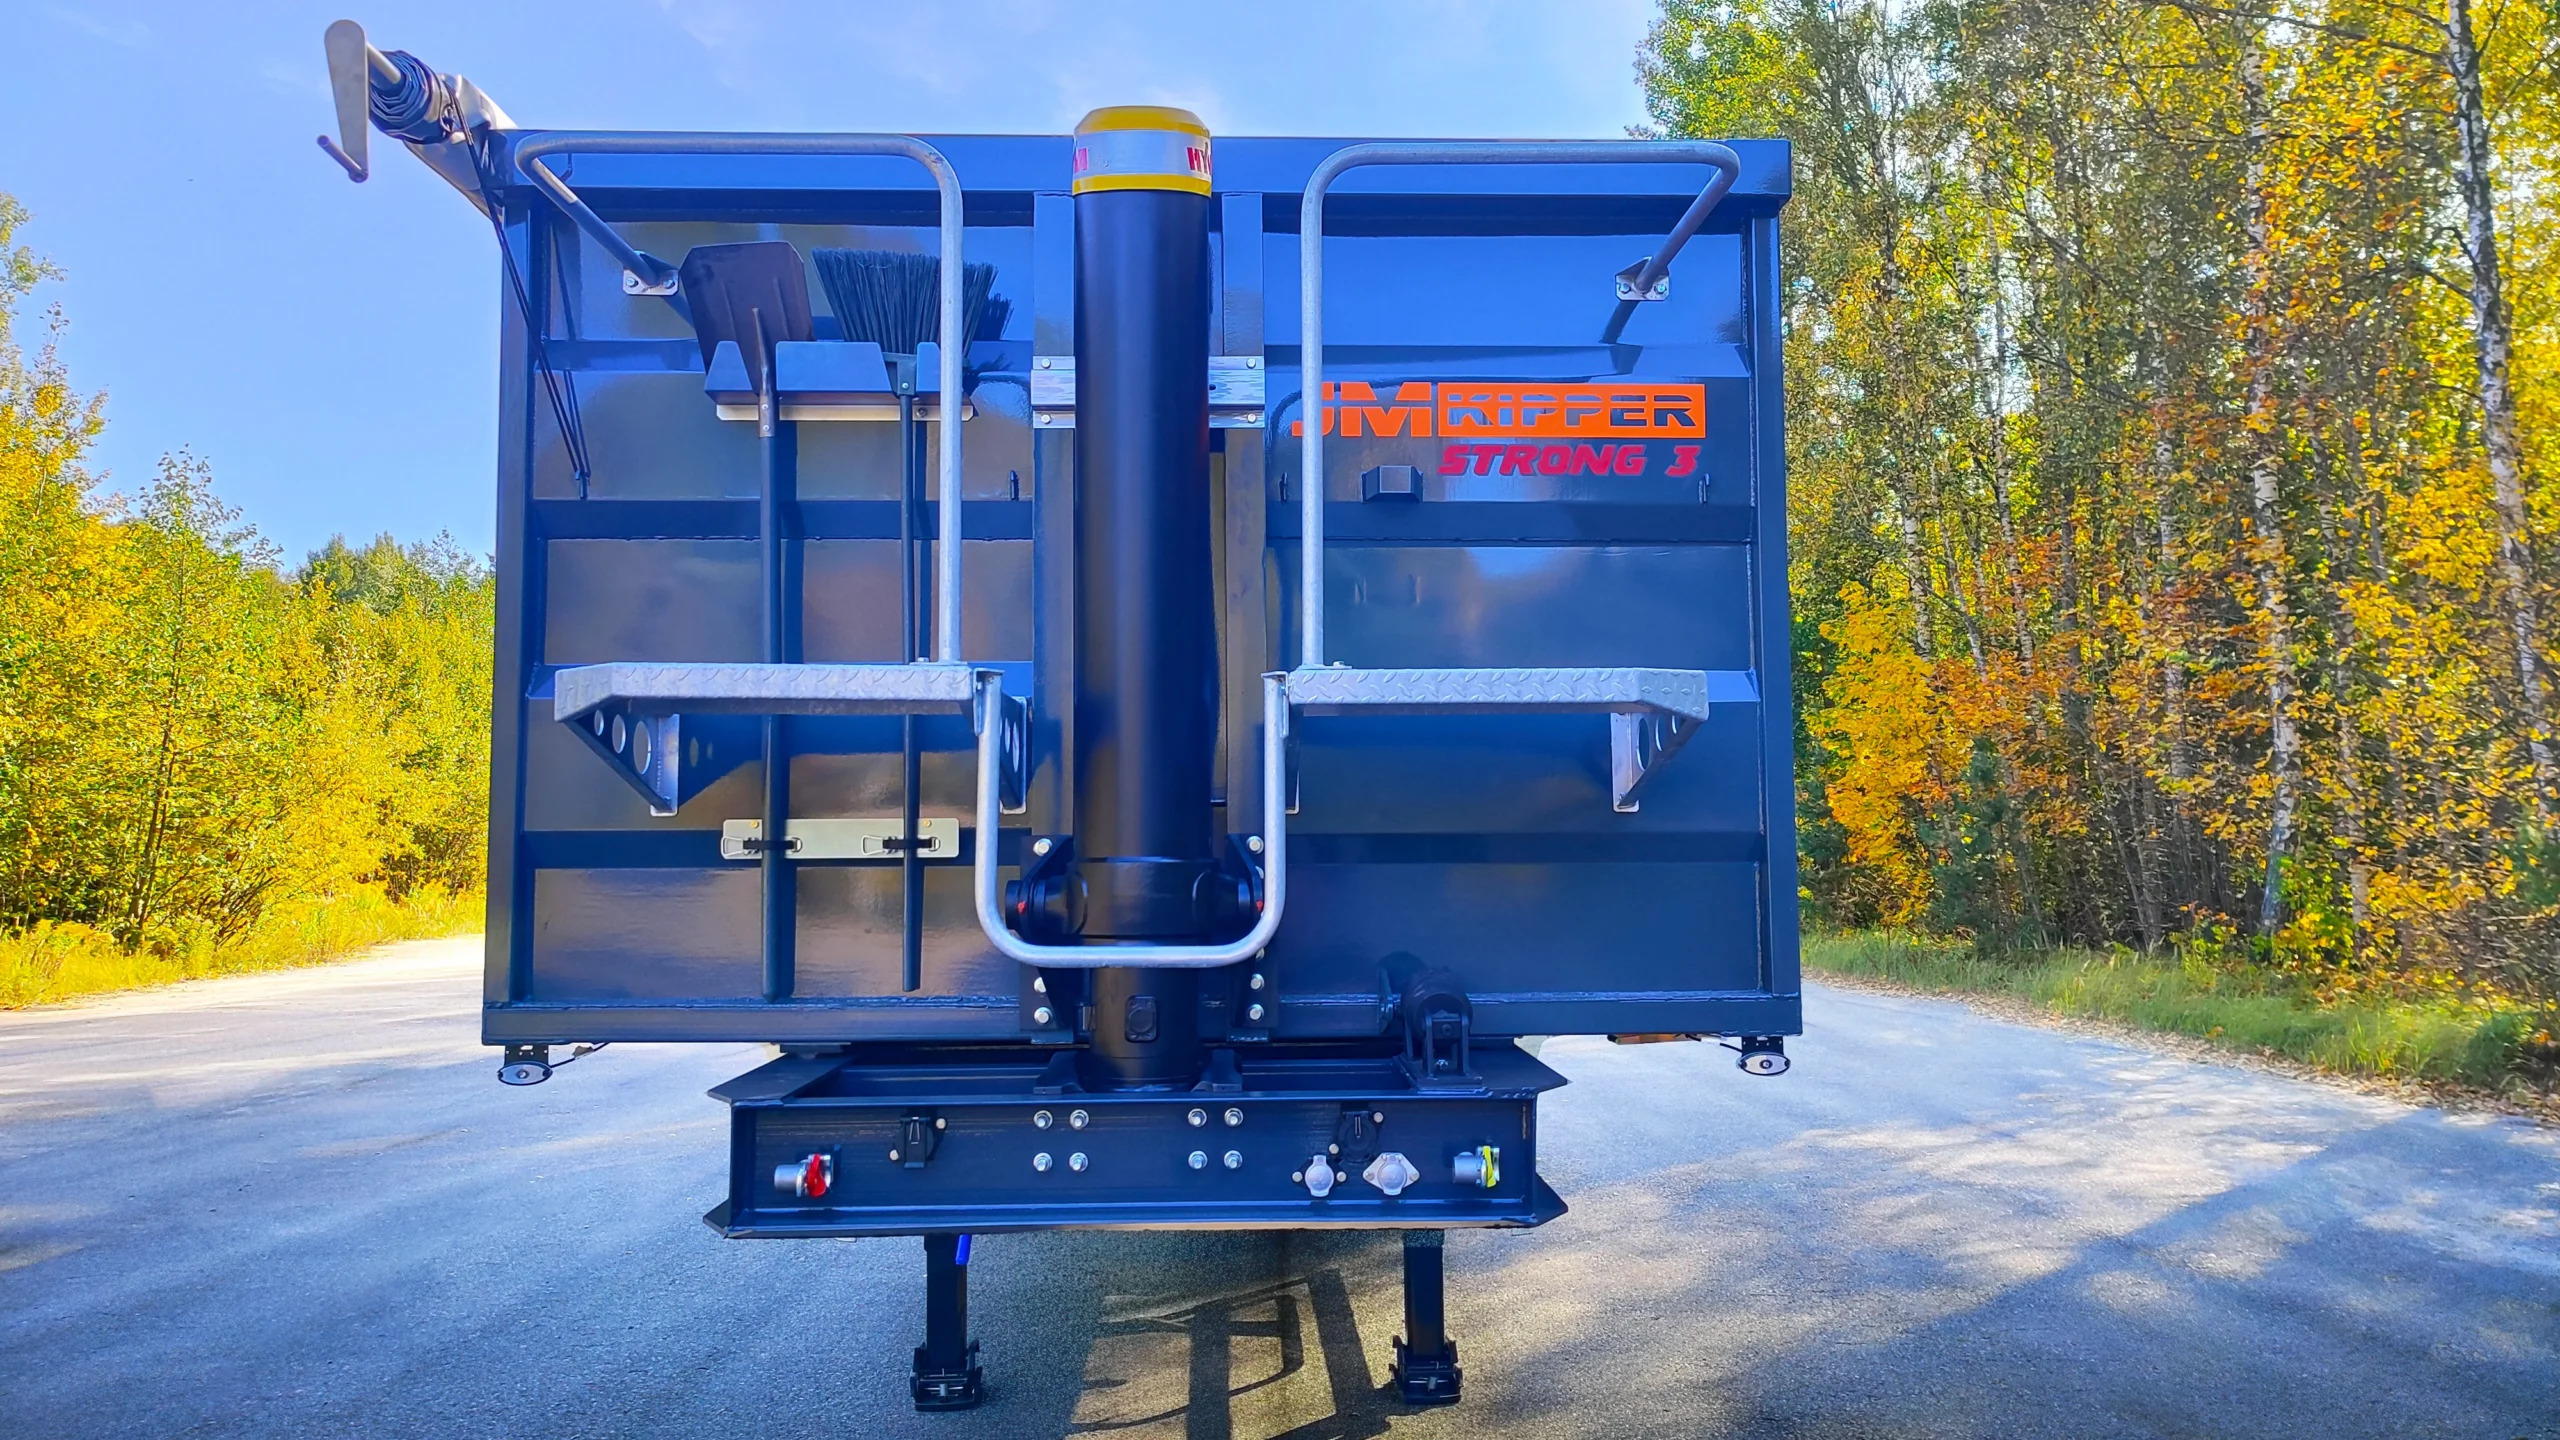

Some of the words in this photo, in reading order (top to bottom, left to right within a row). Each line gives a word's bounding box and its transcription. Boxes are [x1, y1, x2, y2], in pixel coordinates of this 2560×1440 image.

[1447, 393, 1697, 427] KIPPER
[1437, 444, 1647, 477] STRONG
[1665, 446, 1702, 477] 3
